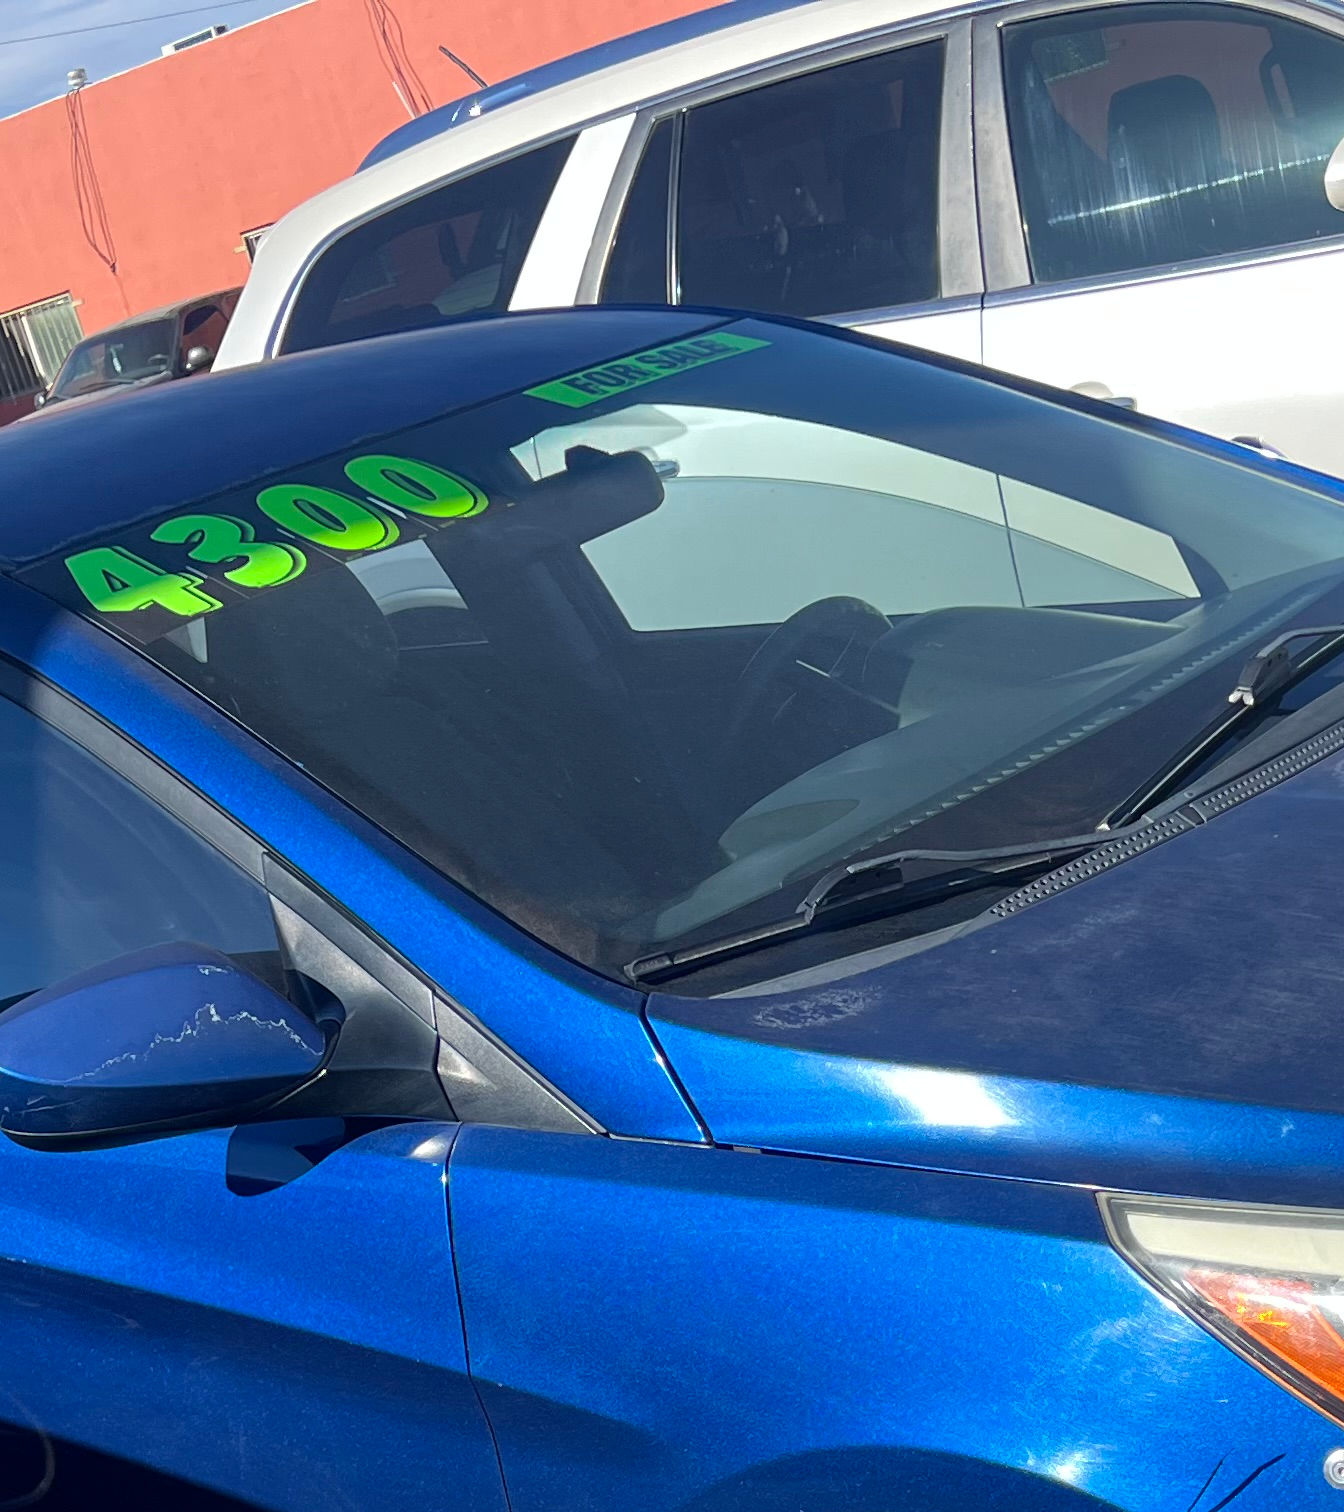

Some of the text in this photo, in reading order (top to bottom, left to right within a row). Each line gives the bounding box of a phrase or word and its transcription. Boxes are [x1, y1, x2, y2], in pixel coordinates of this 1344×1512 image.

[563, 339, 733, 395] FOR SALE
[65, 455, 489, 617] 4300
